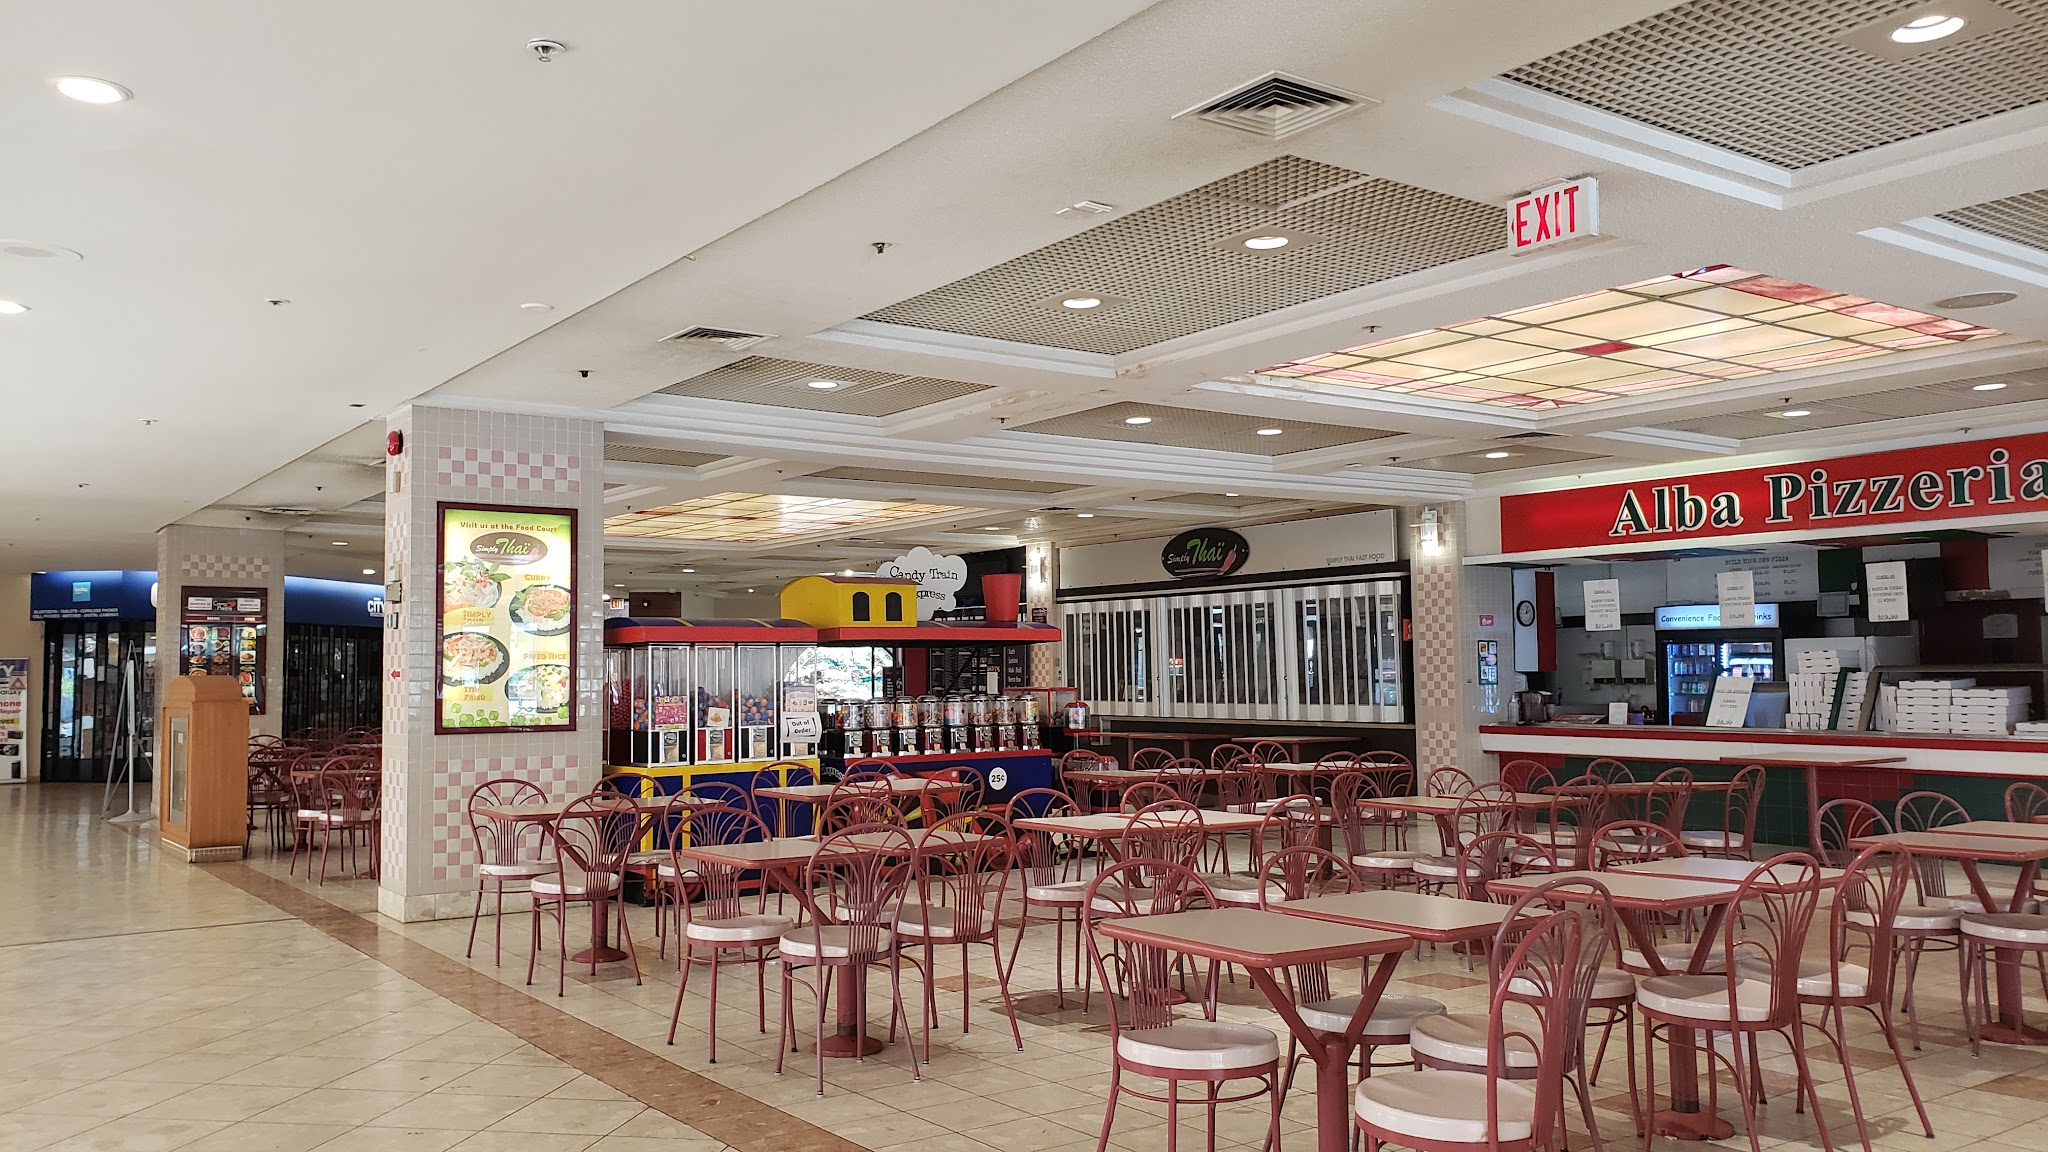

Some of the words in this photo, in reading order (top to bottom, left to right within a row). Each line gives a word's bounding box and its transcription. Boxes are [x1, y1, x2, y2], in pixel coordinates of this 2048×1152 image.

[1515, 185, 1579, 248] EXIT
[1608, 484, 1744, 538] Alba
[1764, 447, 2048, 524] Pizzeria
[460, 521, 478, 529] Visit
[536, 525, 558, 533] Court
[475, 544, 499, 554] Simply
[1166, 552, 1191, 565] Simply
[1369, 552, 1385, 560] FOOD
[889, 565, 927, 583] Candy
[929, 567, 959, 581] Train
[916, 590, 946, 601] press
[611, 600, 623, 609] EXIT
[463, 610, 492, 618] SIMPLY
[1660, 615, 1705, 623] Convenience
[1707, 613, 1721, 622] Foo
[1753, 613, 1772, 621] inks
[549, 652, 568, 660] RICE
[991, 774, 1005, 783] 25¢
